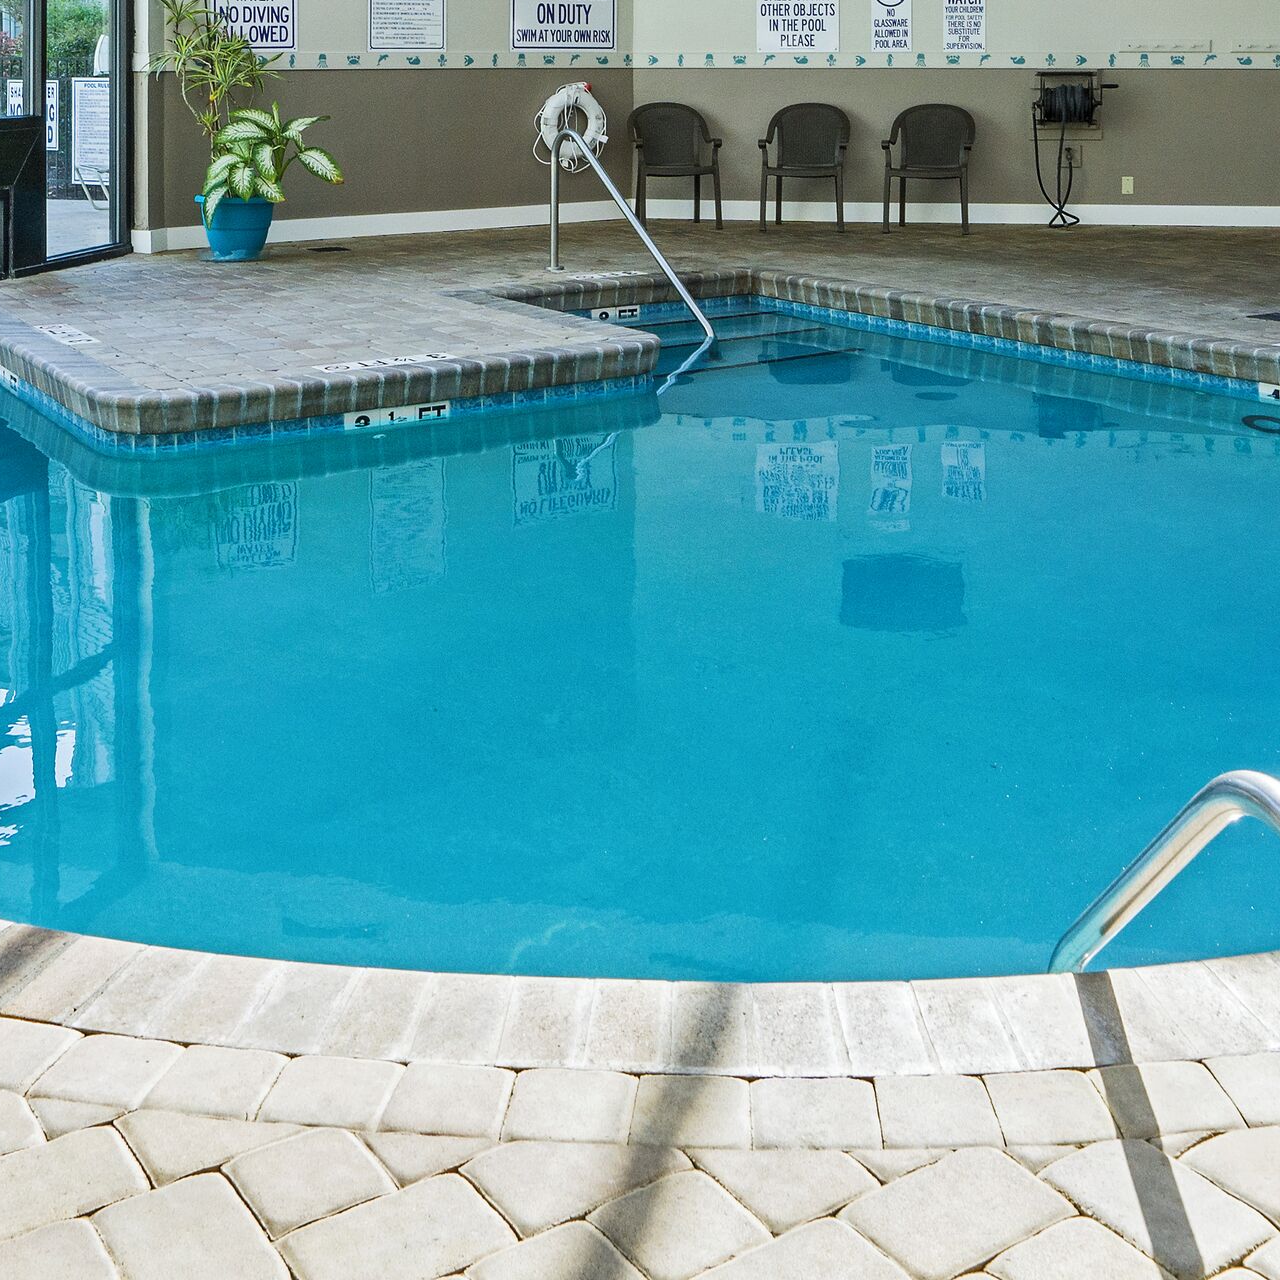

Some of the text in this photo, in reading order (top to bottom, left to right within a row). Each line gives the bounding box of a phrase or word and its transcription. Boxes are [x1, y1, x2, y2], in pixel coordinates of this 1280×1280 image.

[537, 3, 592, 25] ON DUTY
[760, 3, 836, 16] OTHER OBJECTS
[886, 8, 896, 17] NO
[945, 5, 959, 13] YOUR
[219, 6, 290, 23] NO DIVING
[769, 18, 827, 32] IN THE POOL
[873, 18, 909, 28] GLASSWARE
[948, 20, 982, 28] THERE IS NO
[516, 28, 611, 43] SWIM AT YOUR OWN RISK
[874, 29, 909, 38] ALLOWED IN
[780, 34, 816, 47] PLEASE
[875, 39, 908, 48] POOL AREA
[946, 42, 983, 50] SUPERVISION
